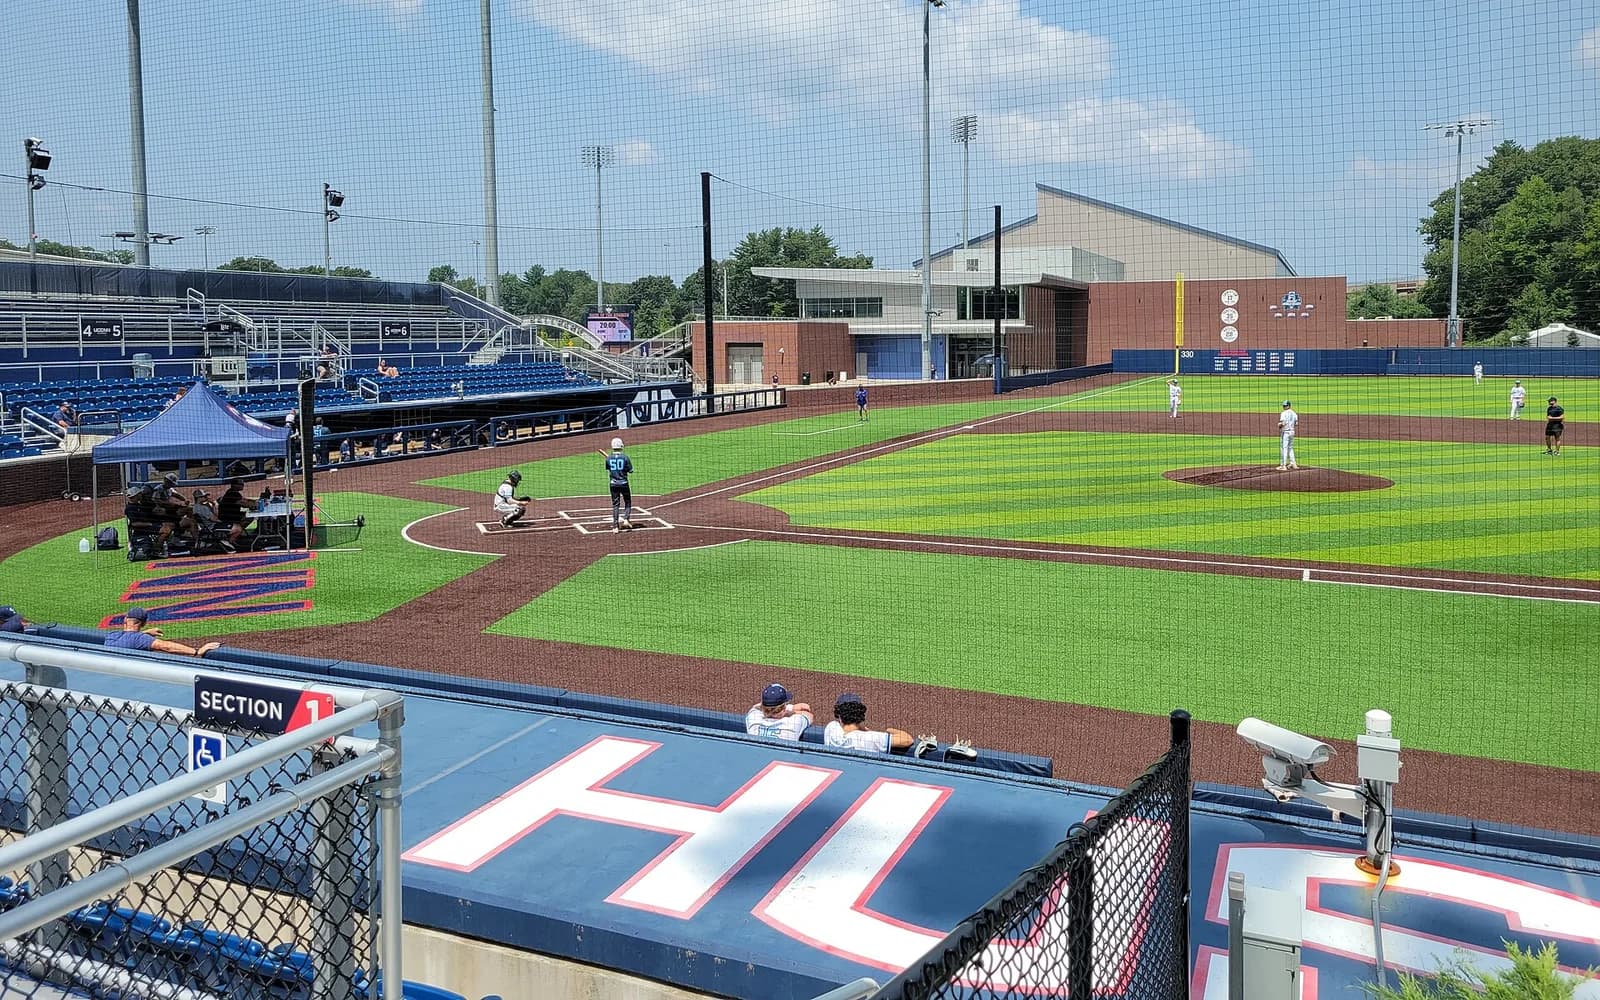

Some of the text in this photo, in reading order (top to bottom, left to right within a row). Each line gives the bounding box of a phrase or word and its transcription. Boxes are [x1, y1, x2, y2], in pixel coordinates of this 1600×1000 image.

[83, 325, 92, 337] 4
[112, 325, 121, 337] 5
[384, 326, 390, 336] 5
[401, 326, 407, 336] 6
[1180, 350, 1194, 358] 330
[610, 459, 624, 470] 50
[200, 690, 319, 723] SECTION 1
